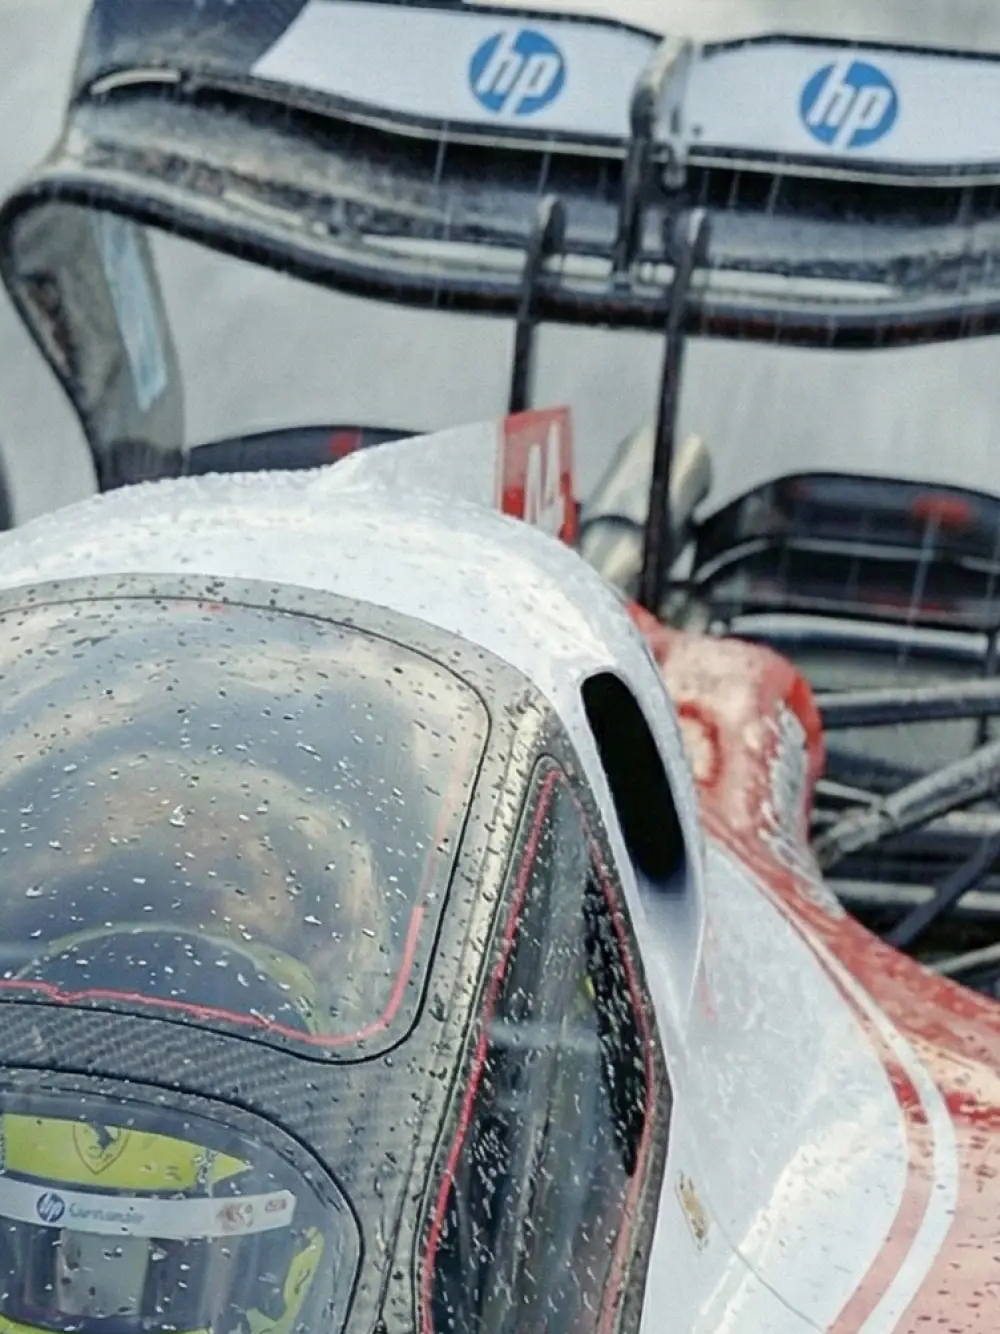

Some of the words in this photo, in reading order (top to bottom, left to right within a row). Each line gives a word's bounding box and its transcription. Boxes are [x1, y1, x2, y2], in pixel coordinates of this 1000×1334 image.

[470, 28, 566, 116] hp
[799, 60, 898, 148] hp
[37, 1192, 65, 1222] hp
